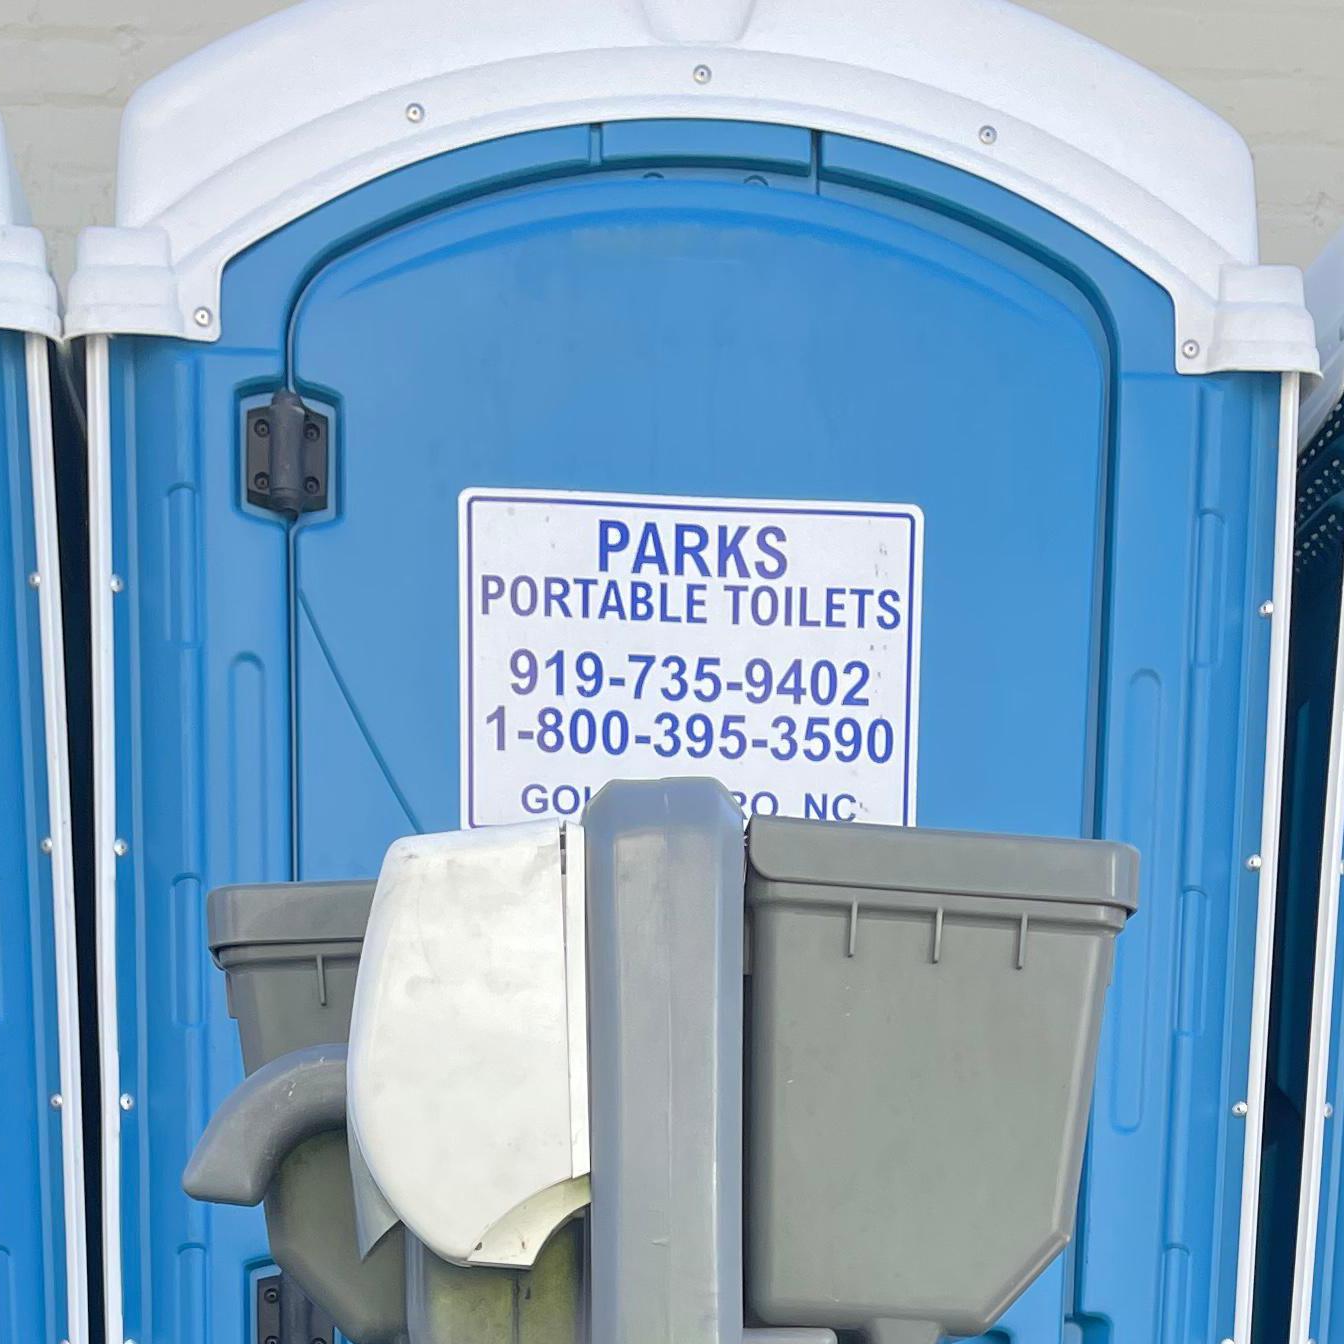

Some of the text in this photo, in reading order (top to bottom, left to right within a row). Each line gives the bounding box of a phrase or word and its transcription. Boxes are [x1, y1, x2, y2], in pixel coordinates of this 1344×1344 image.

[598, 519, 788, 580] PARKS
[480, 574, 901, 631] PORTABLE TOILETS
[509, 648, 871, 707] 919-735-9402
[485, 704, 895, 765] 1-800-395-3590
[803, 791, 857, 823] NC
